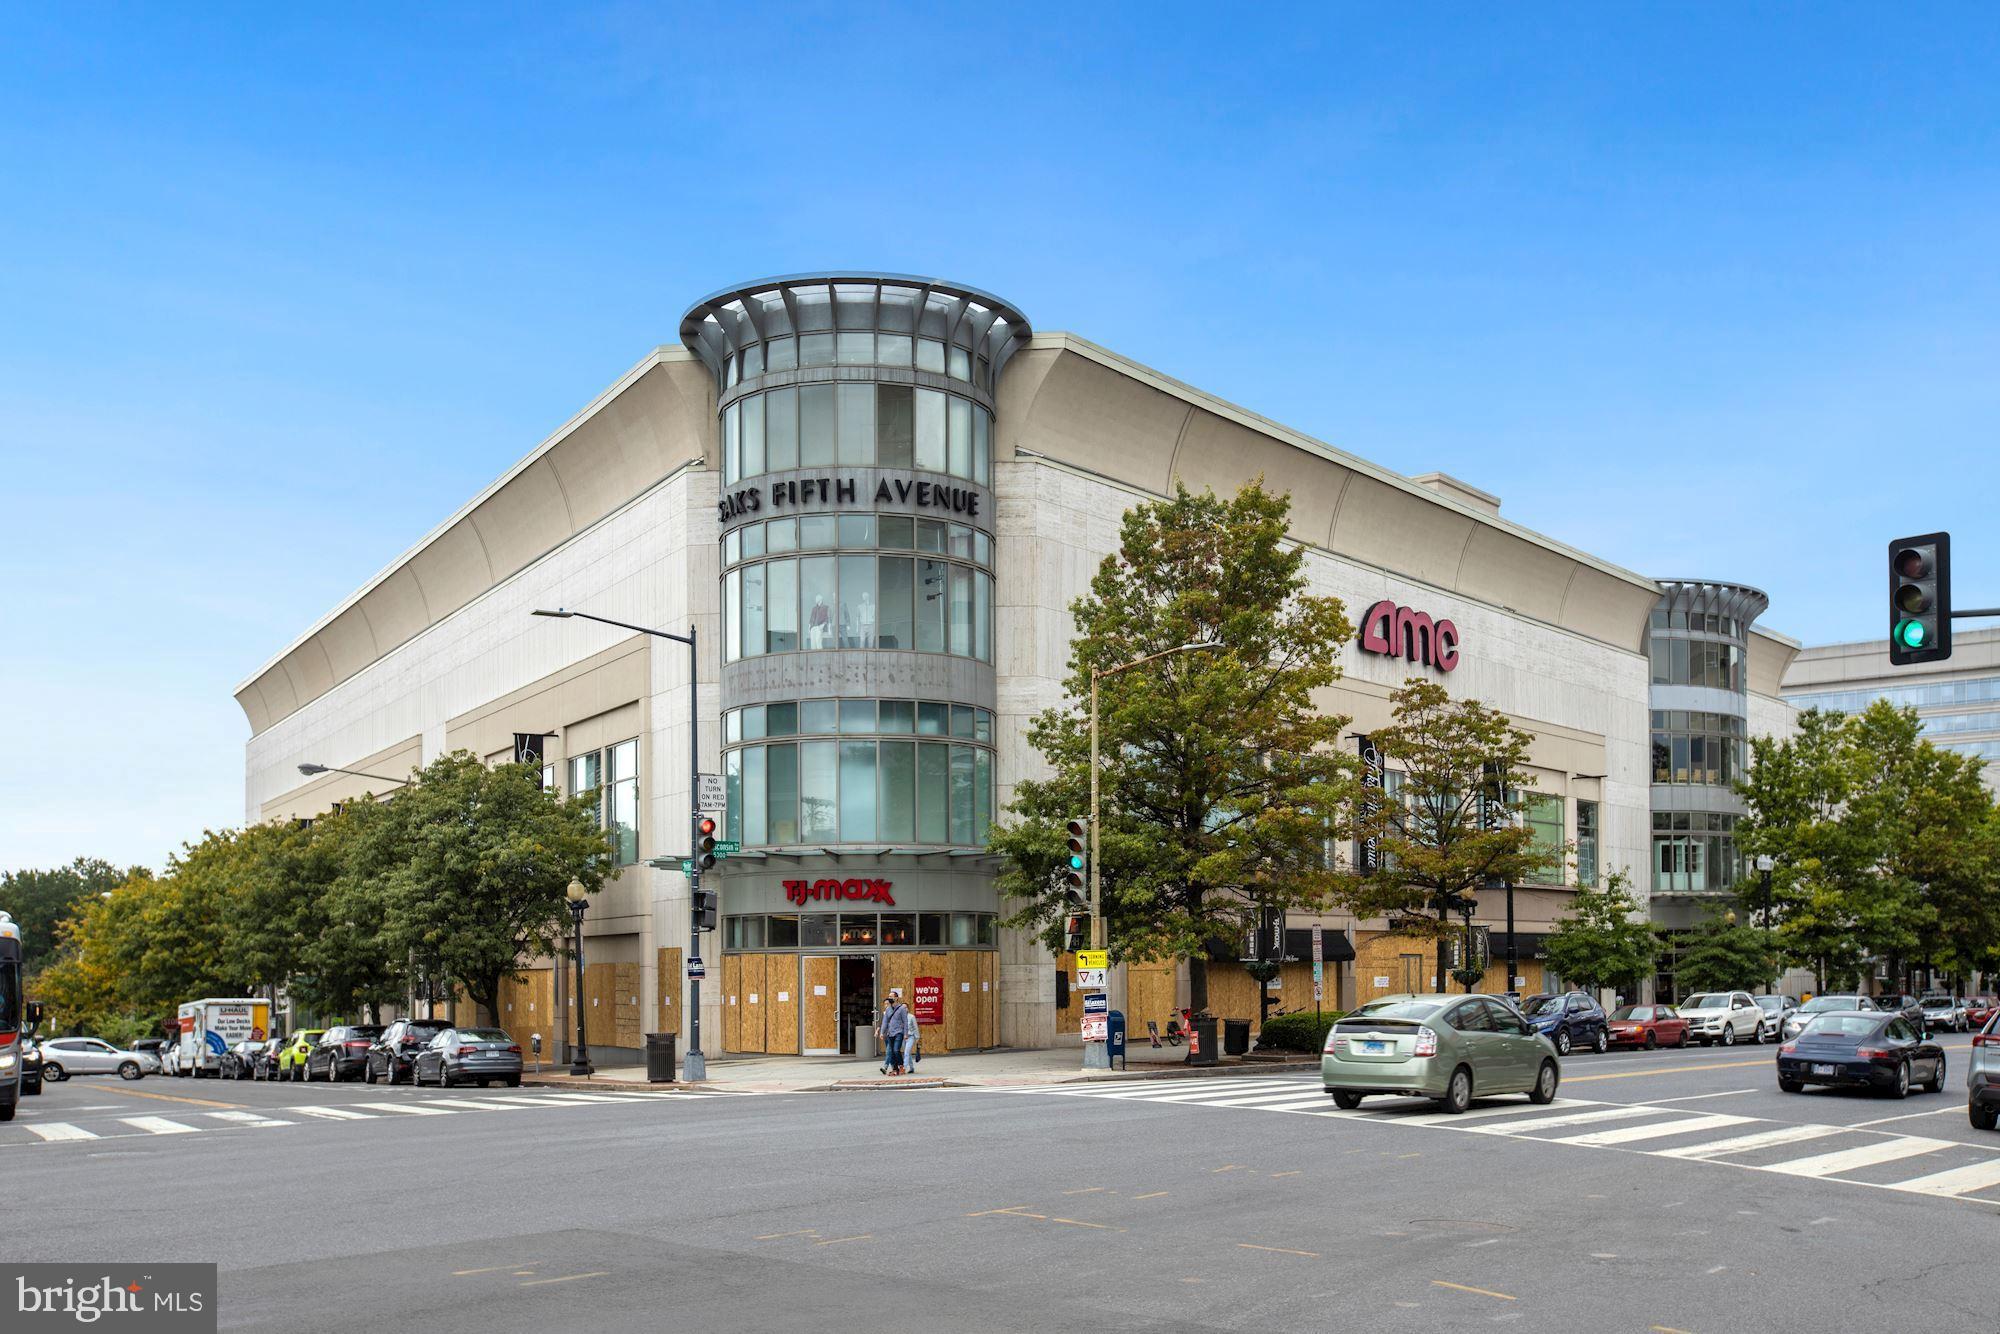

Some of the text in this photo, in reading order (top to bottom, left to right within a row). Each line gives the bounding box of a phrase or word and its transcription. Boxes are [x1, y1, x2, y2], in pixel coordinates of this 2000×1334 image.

[718, 477, 979, 522] SAKS FIFTH AVENUE
[915, 986, 939, 994] we're
[915, 996, 938, 1004] open
